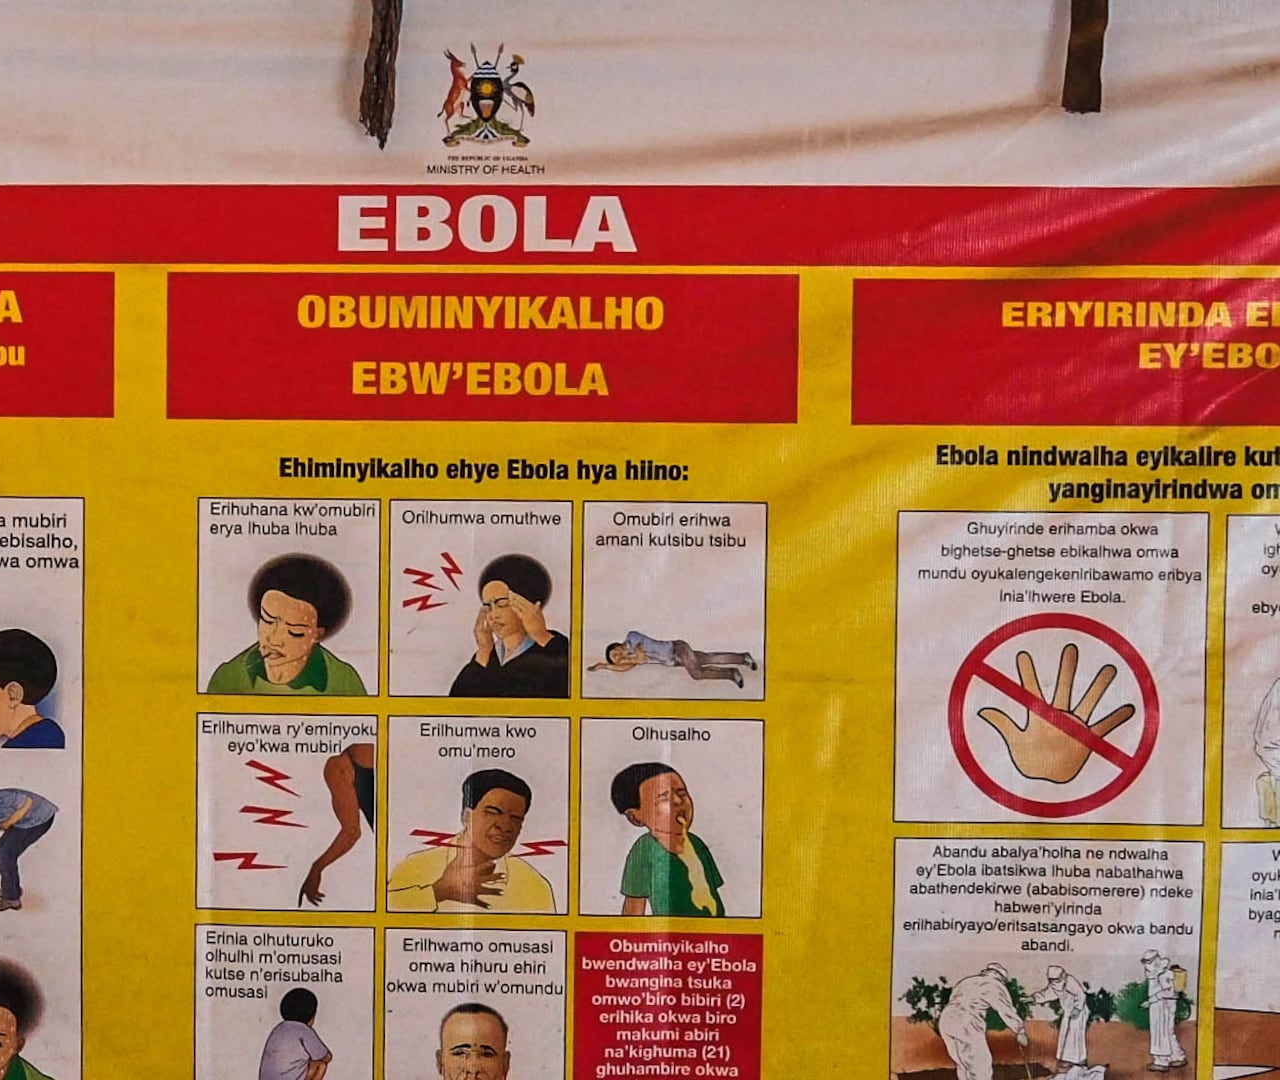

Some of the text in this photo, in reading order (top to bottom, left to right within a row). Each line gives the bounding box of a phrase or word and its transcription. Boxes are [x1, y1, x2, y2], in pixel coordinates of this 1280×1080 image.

[426, 164, 545, 175] MINISTRY OF HEALTH
[337, 194, 638, 253] EBOLA
[297, 294, 665, 331] OBUMINYIKALHO
[1001, 301, 1233, 328] ERIYIRINDA
[352, 361, 609, 396] EBW'EBOLA
[936, 445, 1128, 466] Ebola nindwalha
[279, 457, 689, 486] Ehiminyikalho ehye Ebola hya hiino:
[11, 512, 67, 528] mubiri
[401, 509, 562, 526] Orilhumwa omuthwe
[612, 511, 675, 527] Omubiri
[1048, 522, 1159, 535] erihamba okwa
[1080, 590, 1126, 603] Ebola.
[505, 724, 537, 739] kwo
[631, 726, 711, 743] Olhusalho
[932, 846, 1169, 861] Abandu ne ndwalha
[488, 939, 554, 955] omusasi
[609, 939, 730, 957] Obuminyikalho
[1020, 938, 1075, 952] abandi.
[686, 957, 757, 975] ey'Ebola
[680, 992, 746, 1009] bibiri (2)
[615, 1027, 720, 1042] makumi abiri
[702, 1045, 730, 1061] (21)
